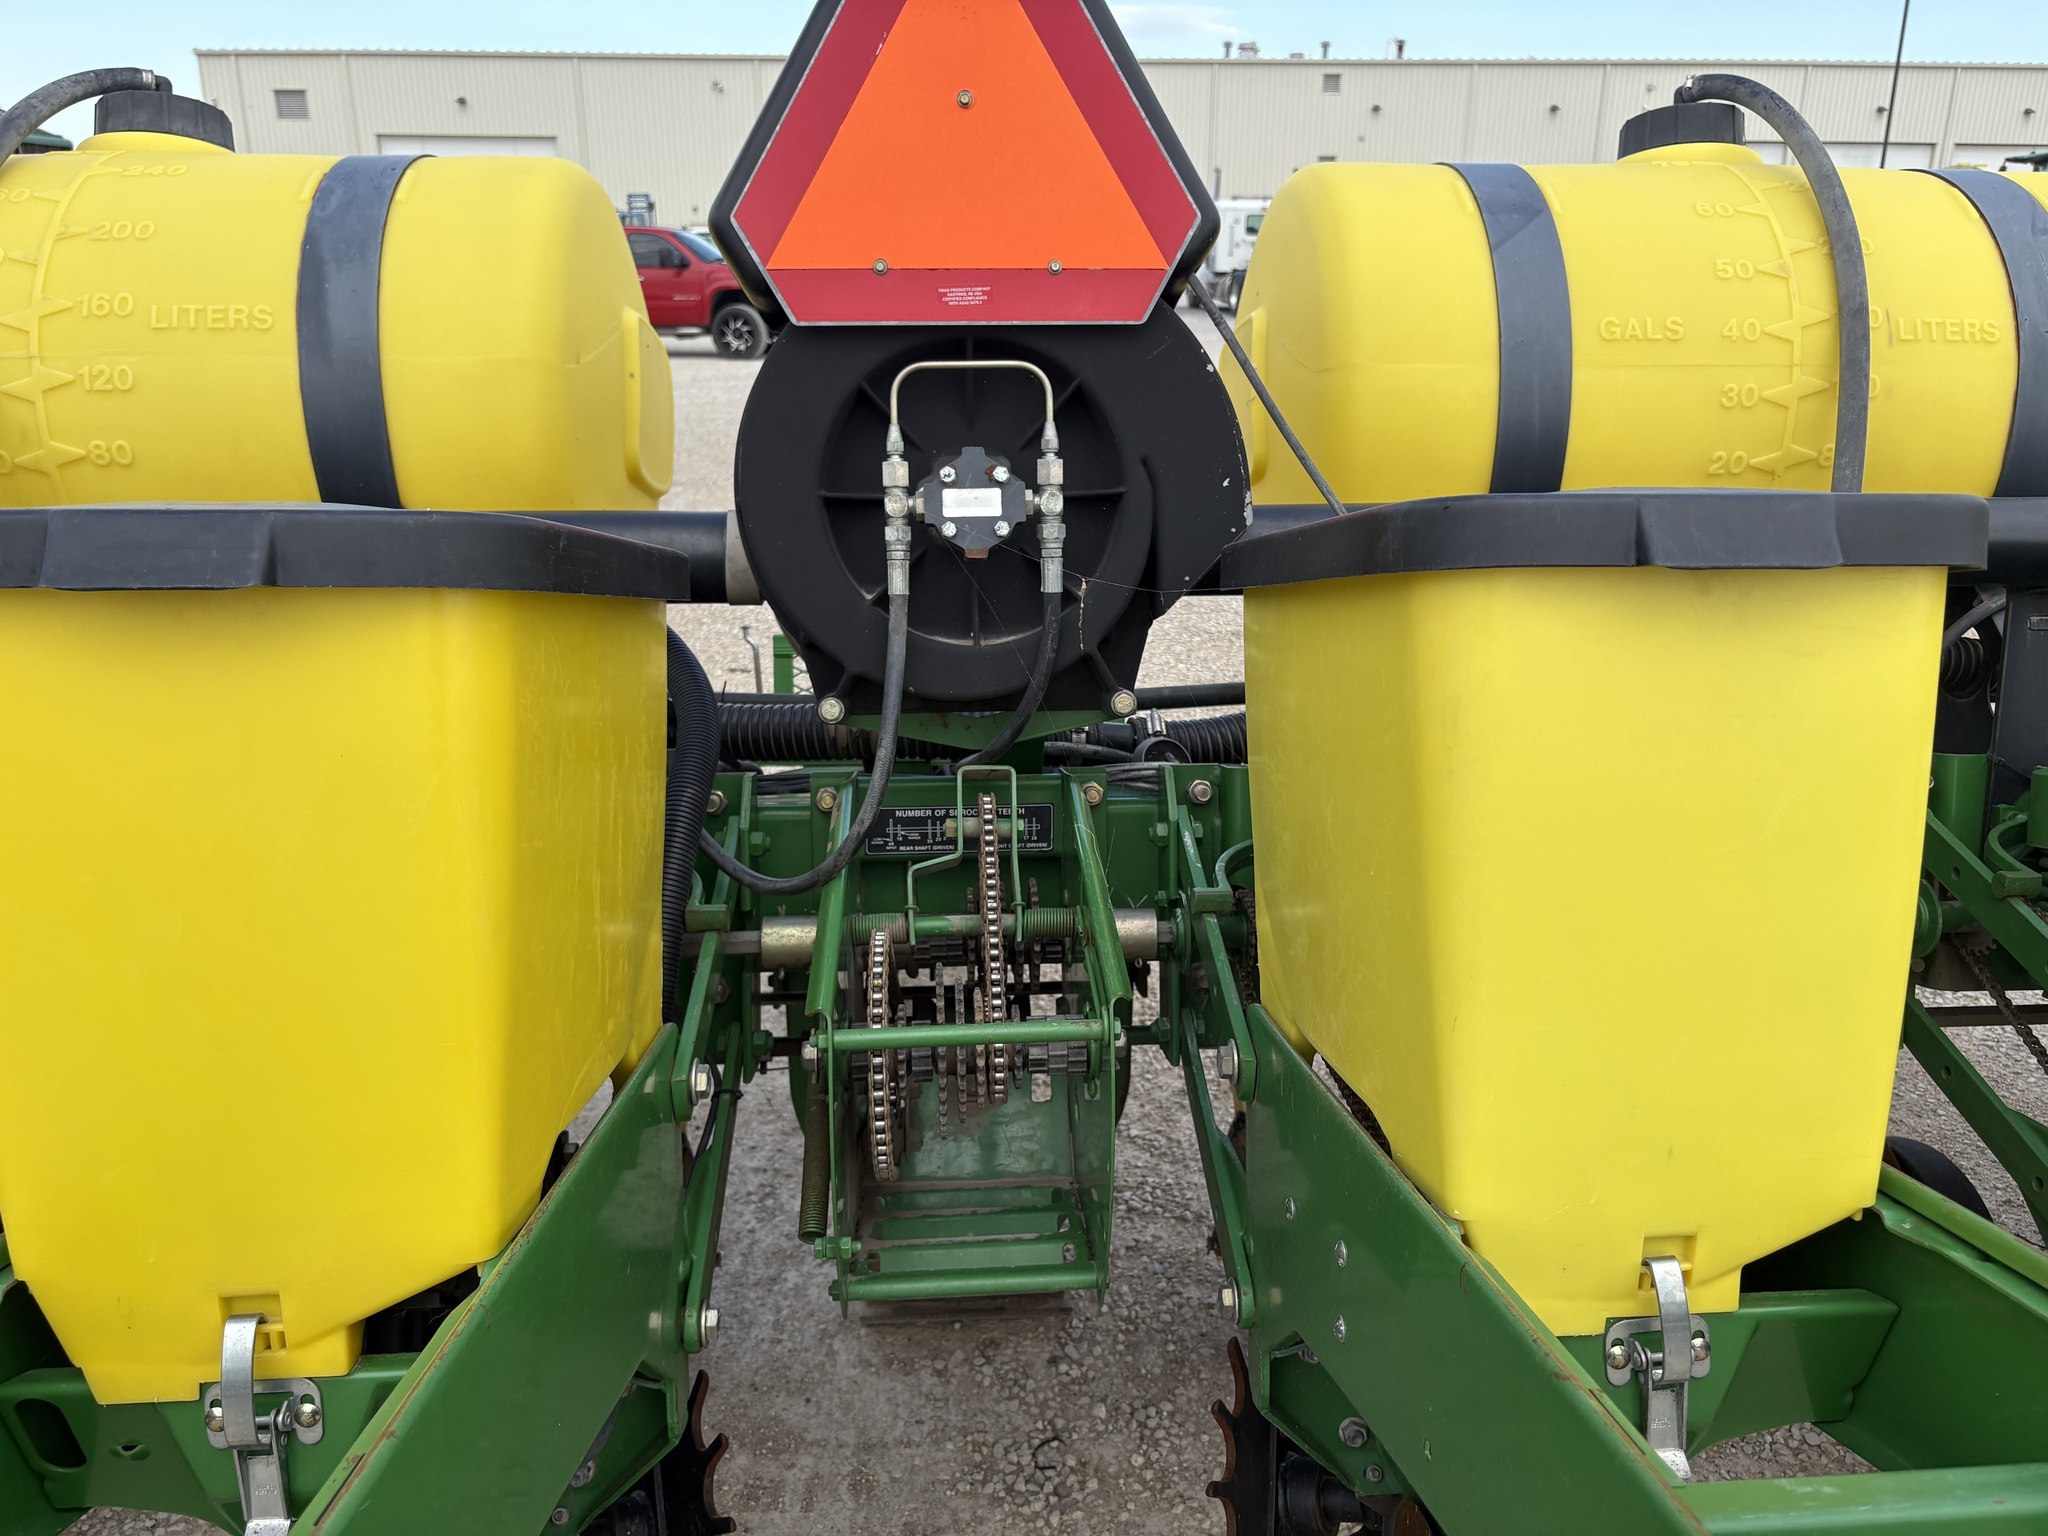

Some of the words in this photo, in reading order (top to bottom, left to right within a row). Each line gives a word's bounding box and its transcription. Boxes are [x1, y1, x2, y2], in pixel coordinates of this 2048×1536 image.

[122, 164, 188, 176] 240
[1695, 201, 1734, 218] 60
[89, 221, 156, 240] 200
[1817, 236, 1874, 255] 20
[1715, 259, 1755, 280] 50
[77, 293, 134, 318] 160
[150, 304, 274, 330] LITERS
[1599, 316, 1686, 342] GALS
[1721, 318, 1762, 342] 40
[1898, 318, 2001, 343] LITERS
[77, 365, 134, 391] 120
[1720, 383, 1760, 408] 30
[87, 440, 134, 467] 80
[1708, 451, 1749, 475] 20
[1817, 443, 1835, 468] 8
[895, 809, 932, 818] NUMBER
[934, 809, 947, 817] OF
